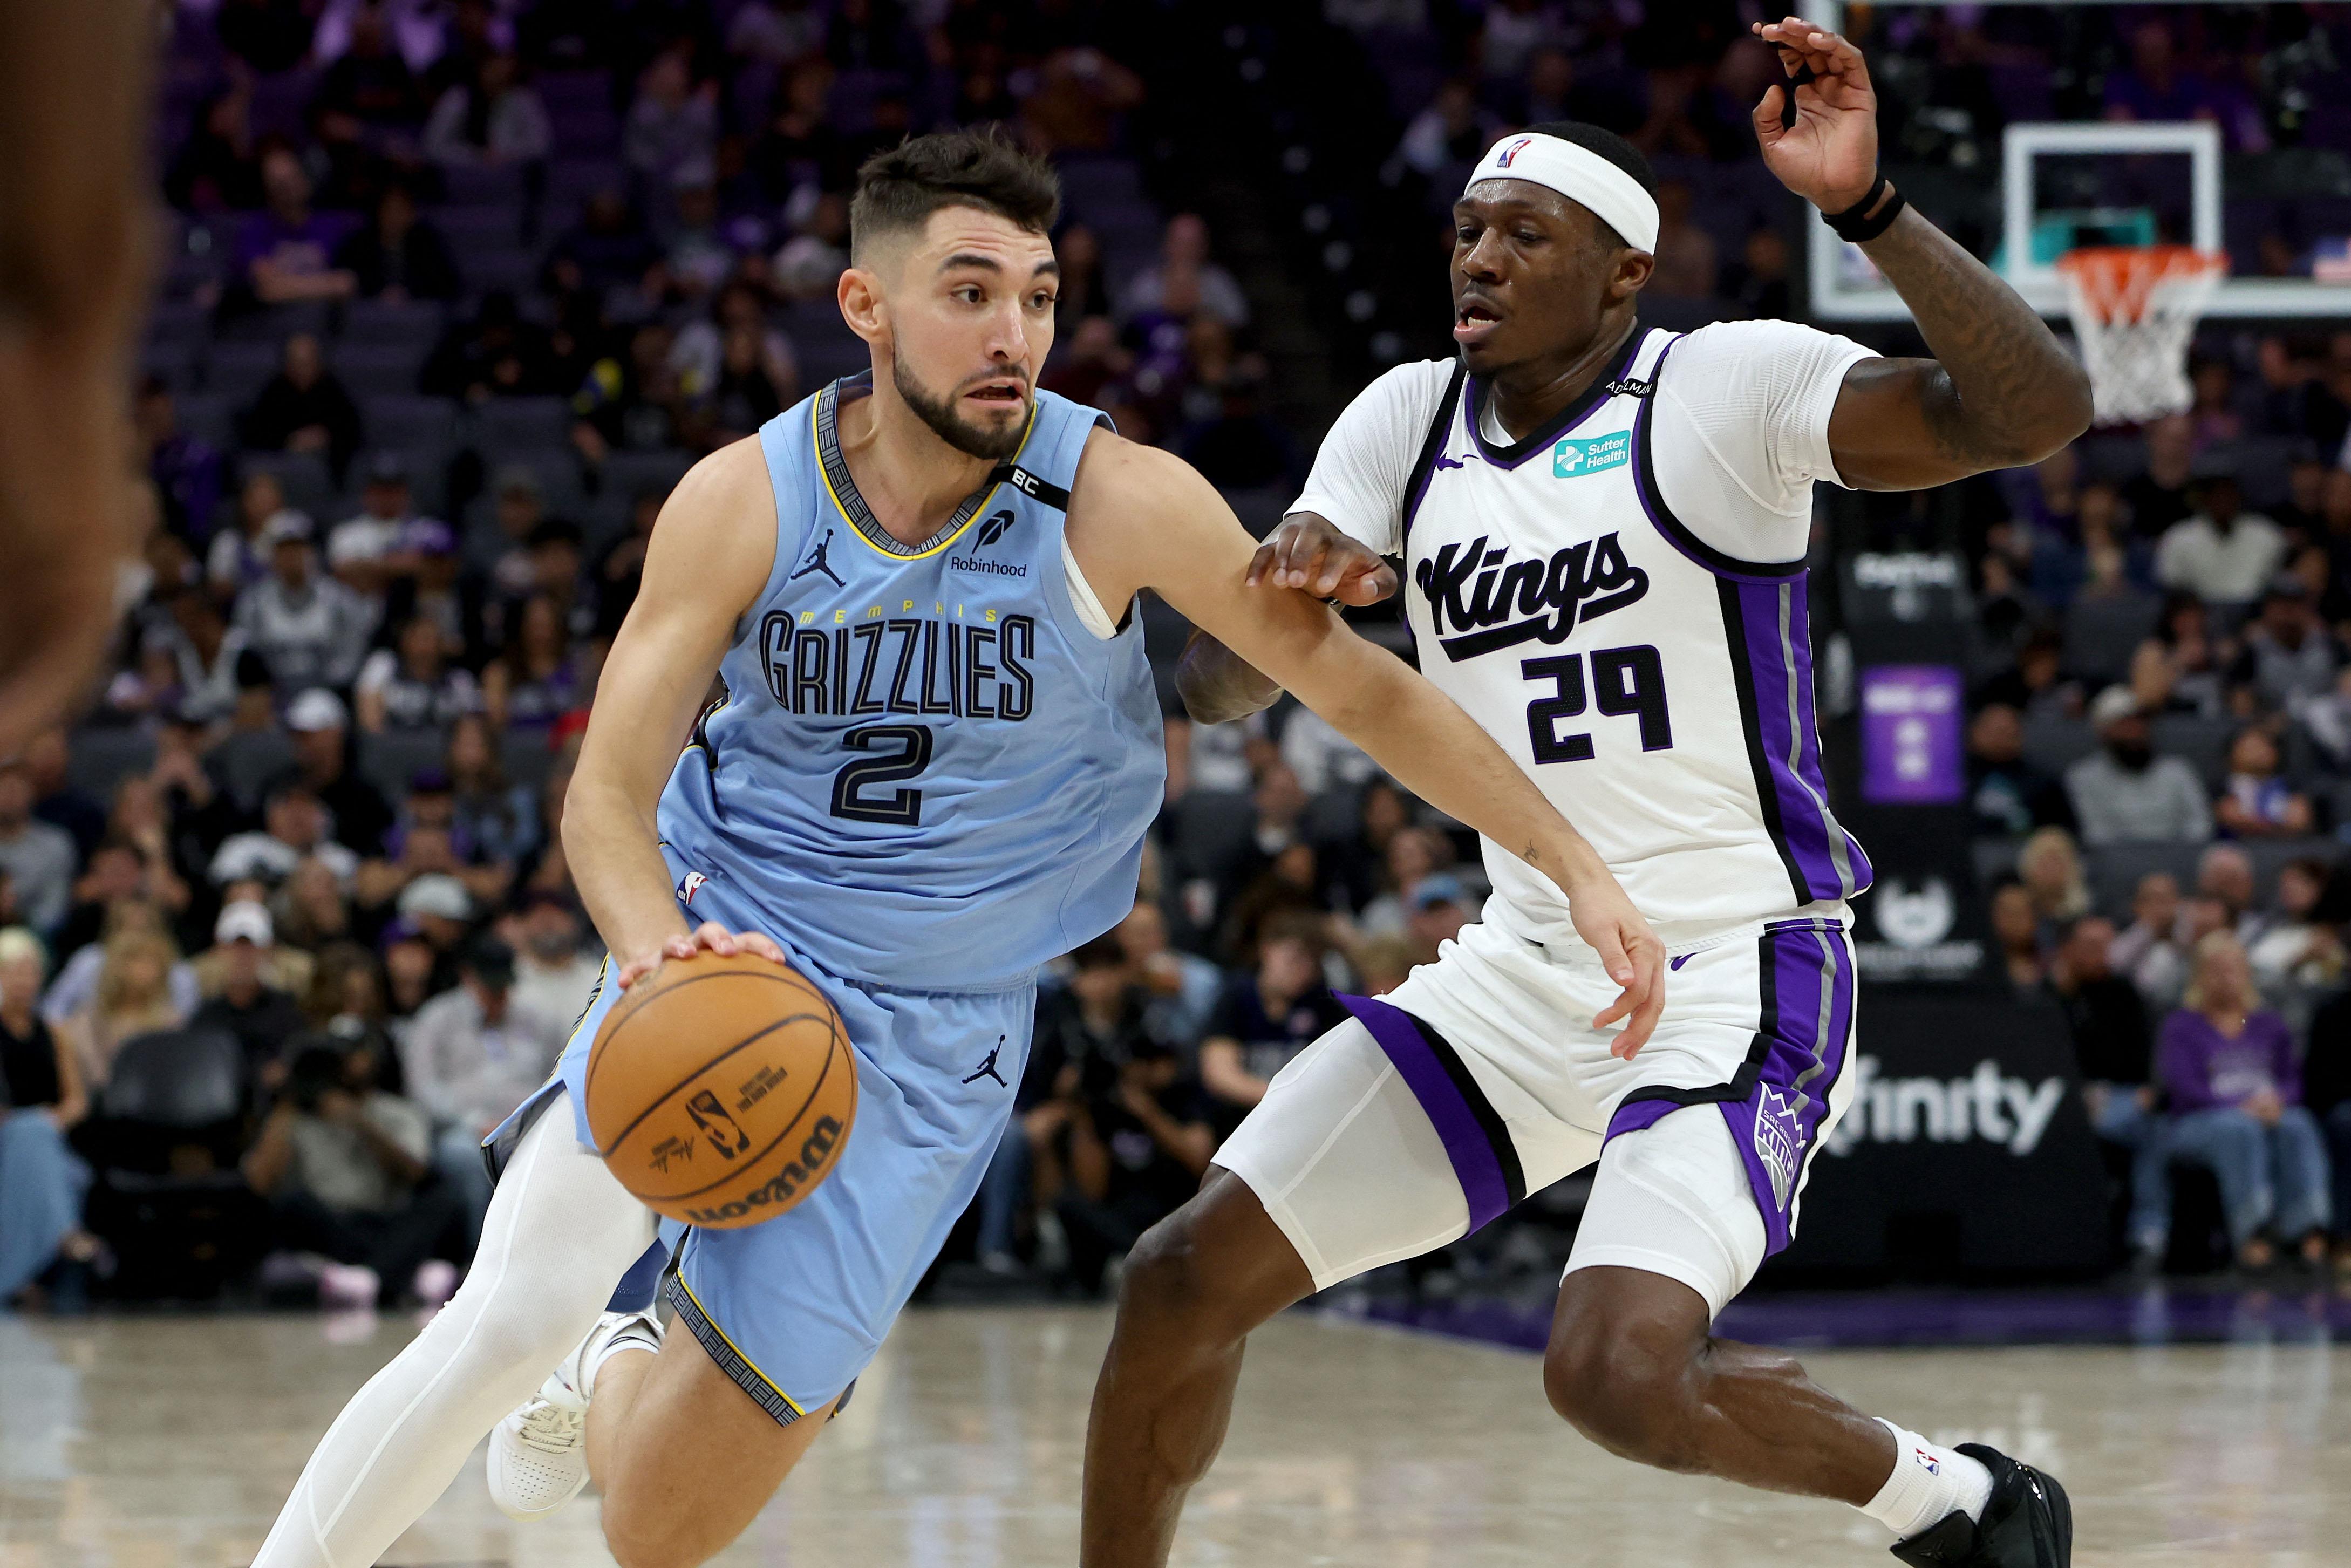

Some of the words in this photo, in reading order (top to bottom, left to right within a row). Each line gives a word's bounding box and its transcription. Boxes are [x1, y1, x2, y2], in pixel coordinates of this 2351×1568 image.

[1605, 381, 1653, 395] ADLMAN
[1586, 449, 1626, 469] Health
[1588, 438, 1626, 455] Sutter
[1012, 468, 1040, 495] BC
[951, 556, 1027, 577] Robinhood
[1415, 531, 1649, 650] Kings
[799, 599, 996, 624] MEMPHIS
[760, 610, 1034, 720] GRIZZLIES
[1521, 644, 1673, 765] 29
[830, 725, 933, 826] 2
[1826, 1053, 2064, 1157] finity
[684, 1115, 843, 1222] Wilson
